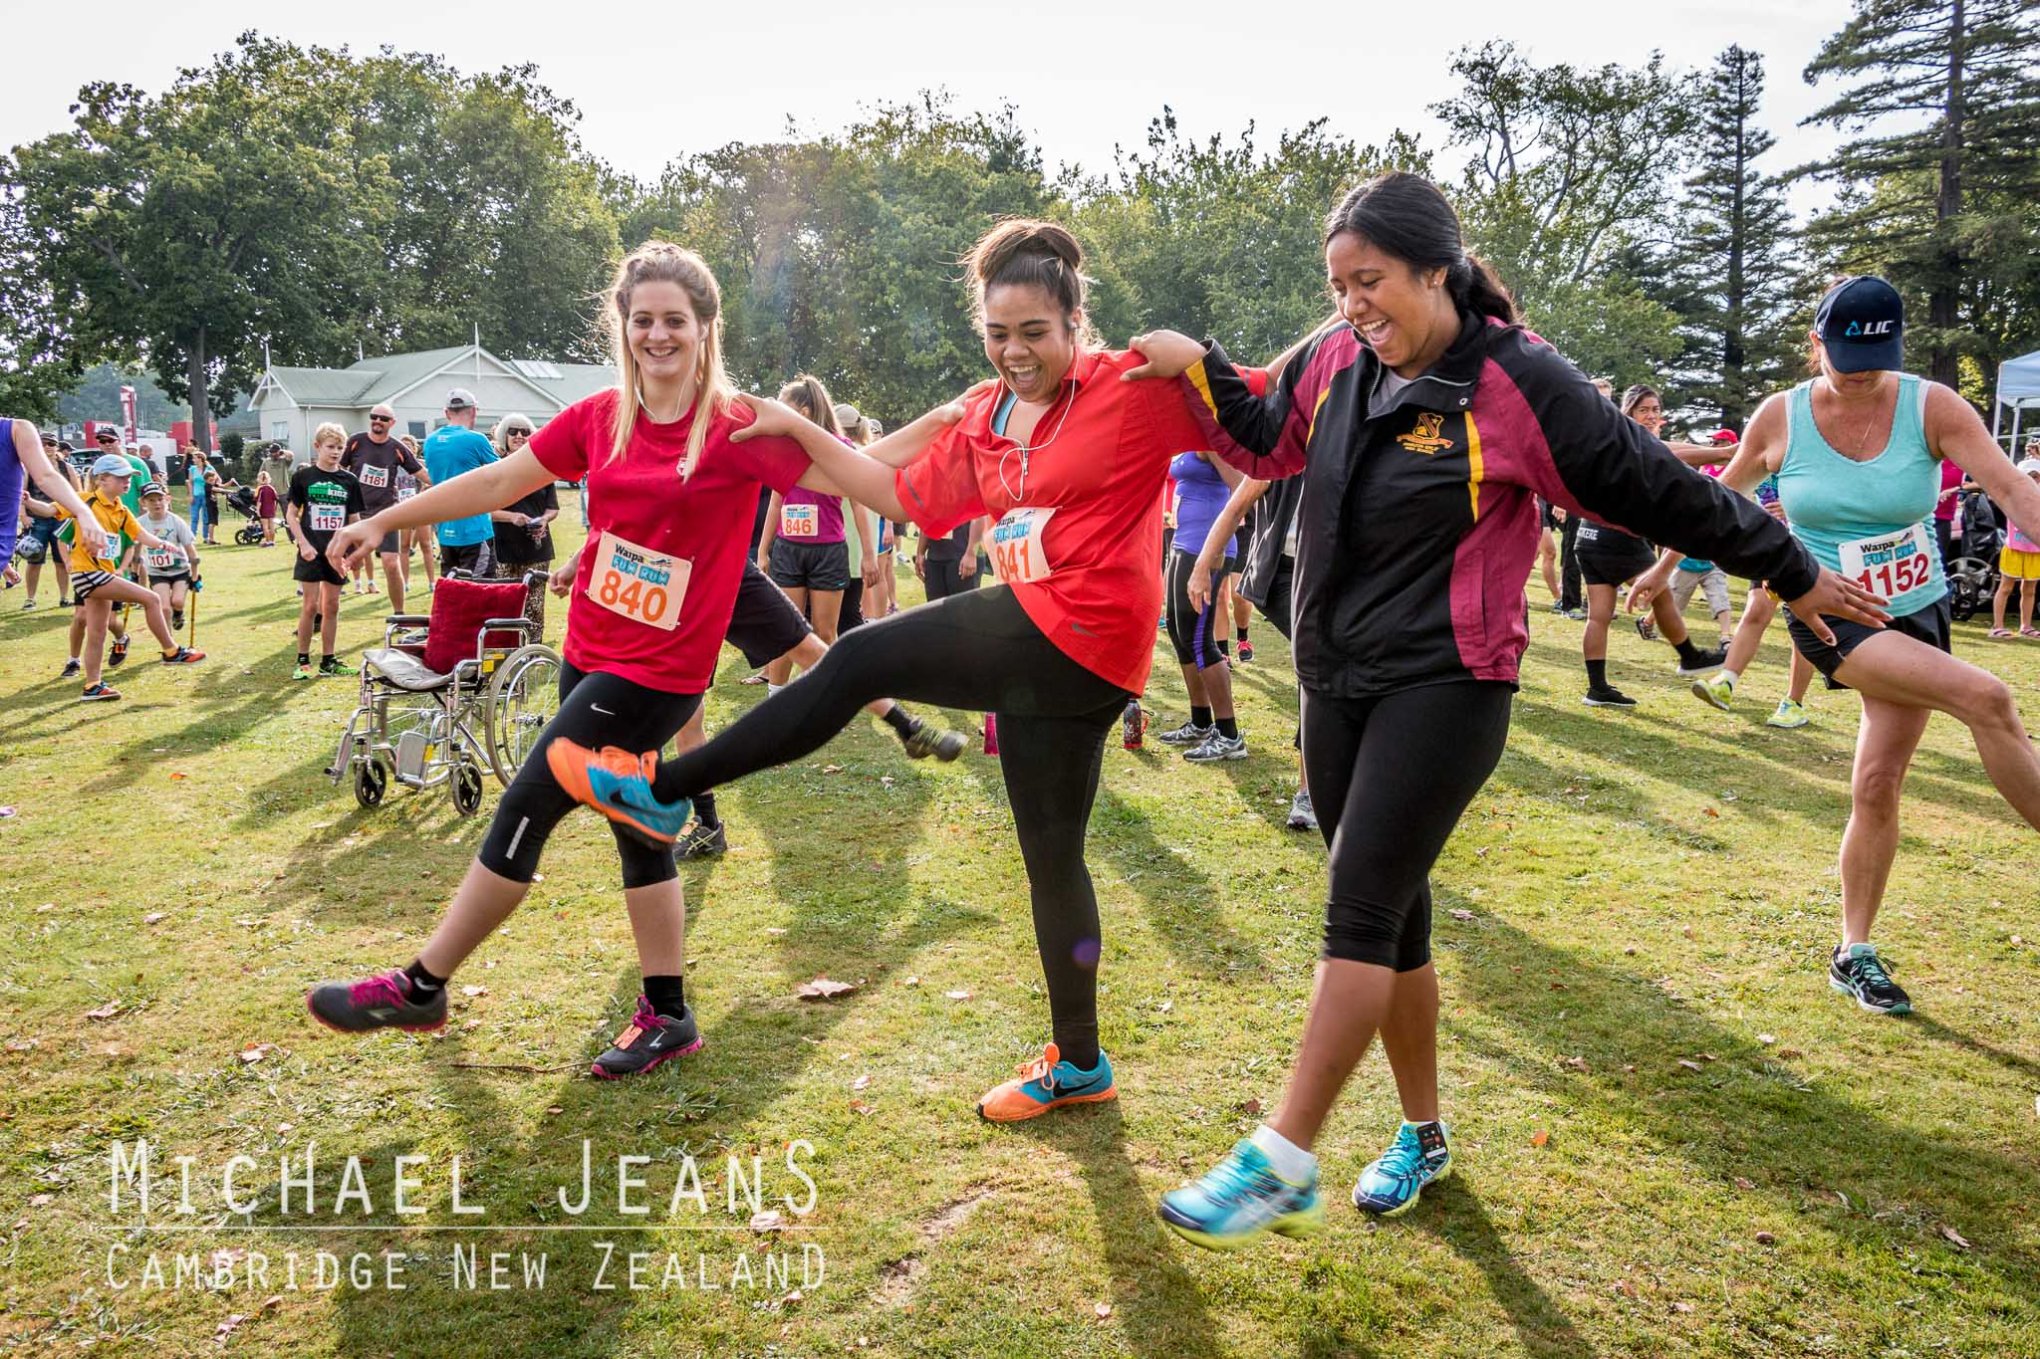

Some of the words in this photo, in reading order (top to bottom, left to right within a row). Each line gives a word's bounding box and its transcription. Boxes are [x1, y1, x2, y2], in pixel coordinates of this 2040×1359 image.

[1863, 320, 1894, 335] LIC
[363, 474, 385, 486] 1181
[316, 516, 343, 529] 1157
[786, 518, 811, 534] 846
[996, 539, 1031, 582] 841
[1863, 549, 1893, 567] FUN
[1894, 541, 1917, 560] RUN
[611, 554, 638, 575] FUN
[638, 565, 671, 586] RUN
[1857, 553, 1929, 596] 1152
[600, 570, 667, 622] 840
